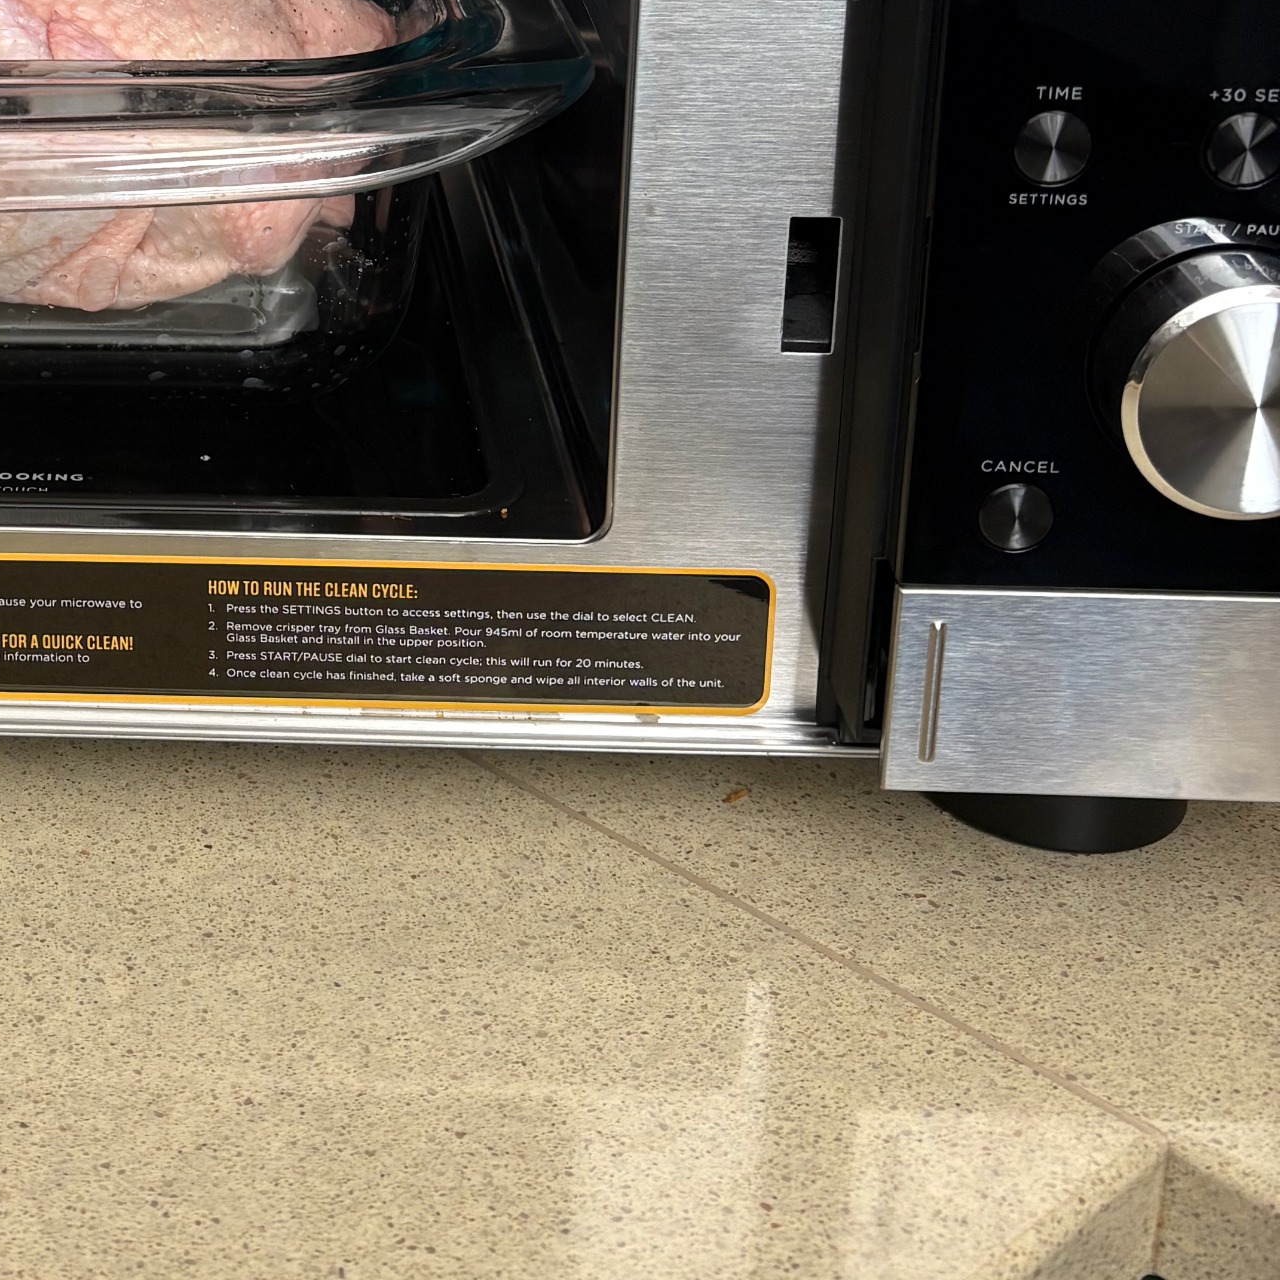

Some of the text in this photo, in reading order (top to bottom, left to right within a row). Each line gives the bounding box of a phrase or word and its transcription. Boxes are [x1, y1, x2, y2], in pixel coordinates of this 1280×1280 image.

[1036, 86, 1082, 100] TIME
[1209, 88, 1247, 103] +30
[1008, 193, 1087, 205] SETTINGS
[980, 459, 1059, 473] CANCEL
[208, 580, 417, 598] HOW TO RUN THE CLEAN CYCLE:
[2, 633, 26, 648] FOR
[30, 634, 38, 648] A
[42, 634, 83, 649] QUICK
[86, 635, 133, 650] CLEAN!
[226, 633, 486, 647] Glass Basket and install in the upper position.
